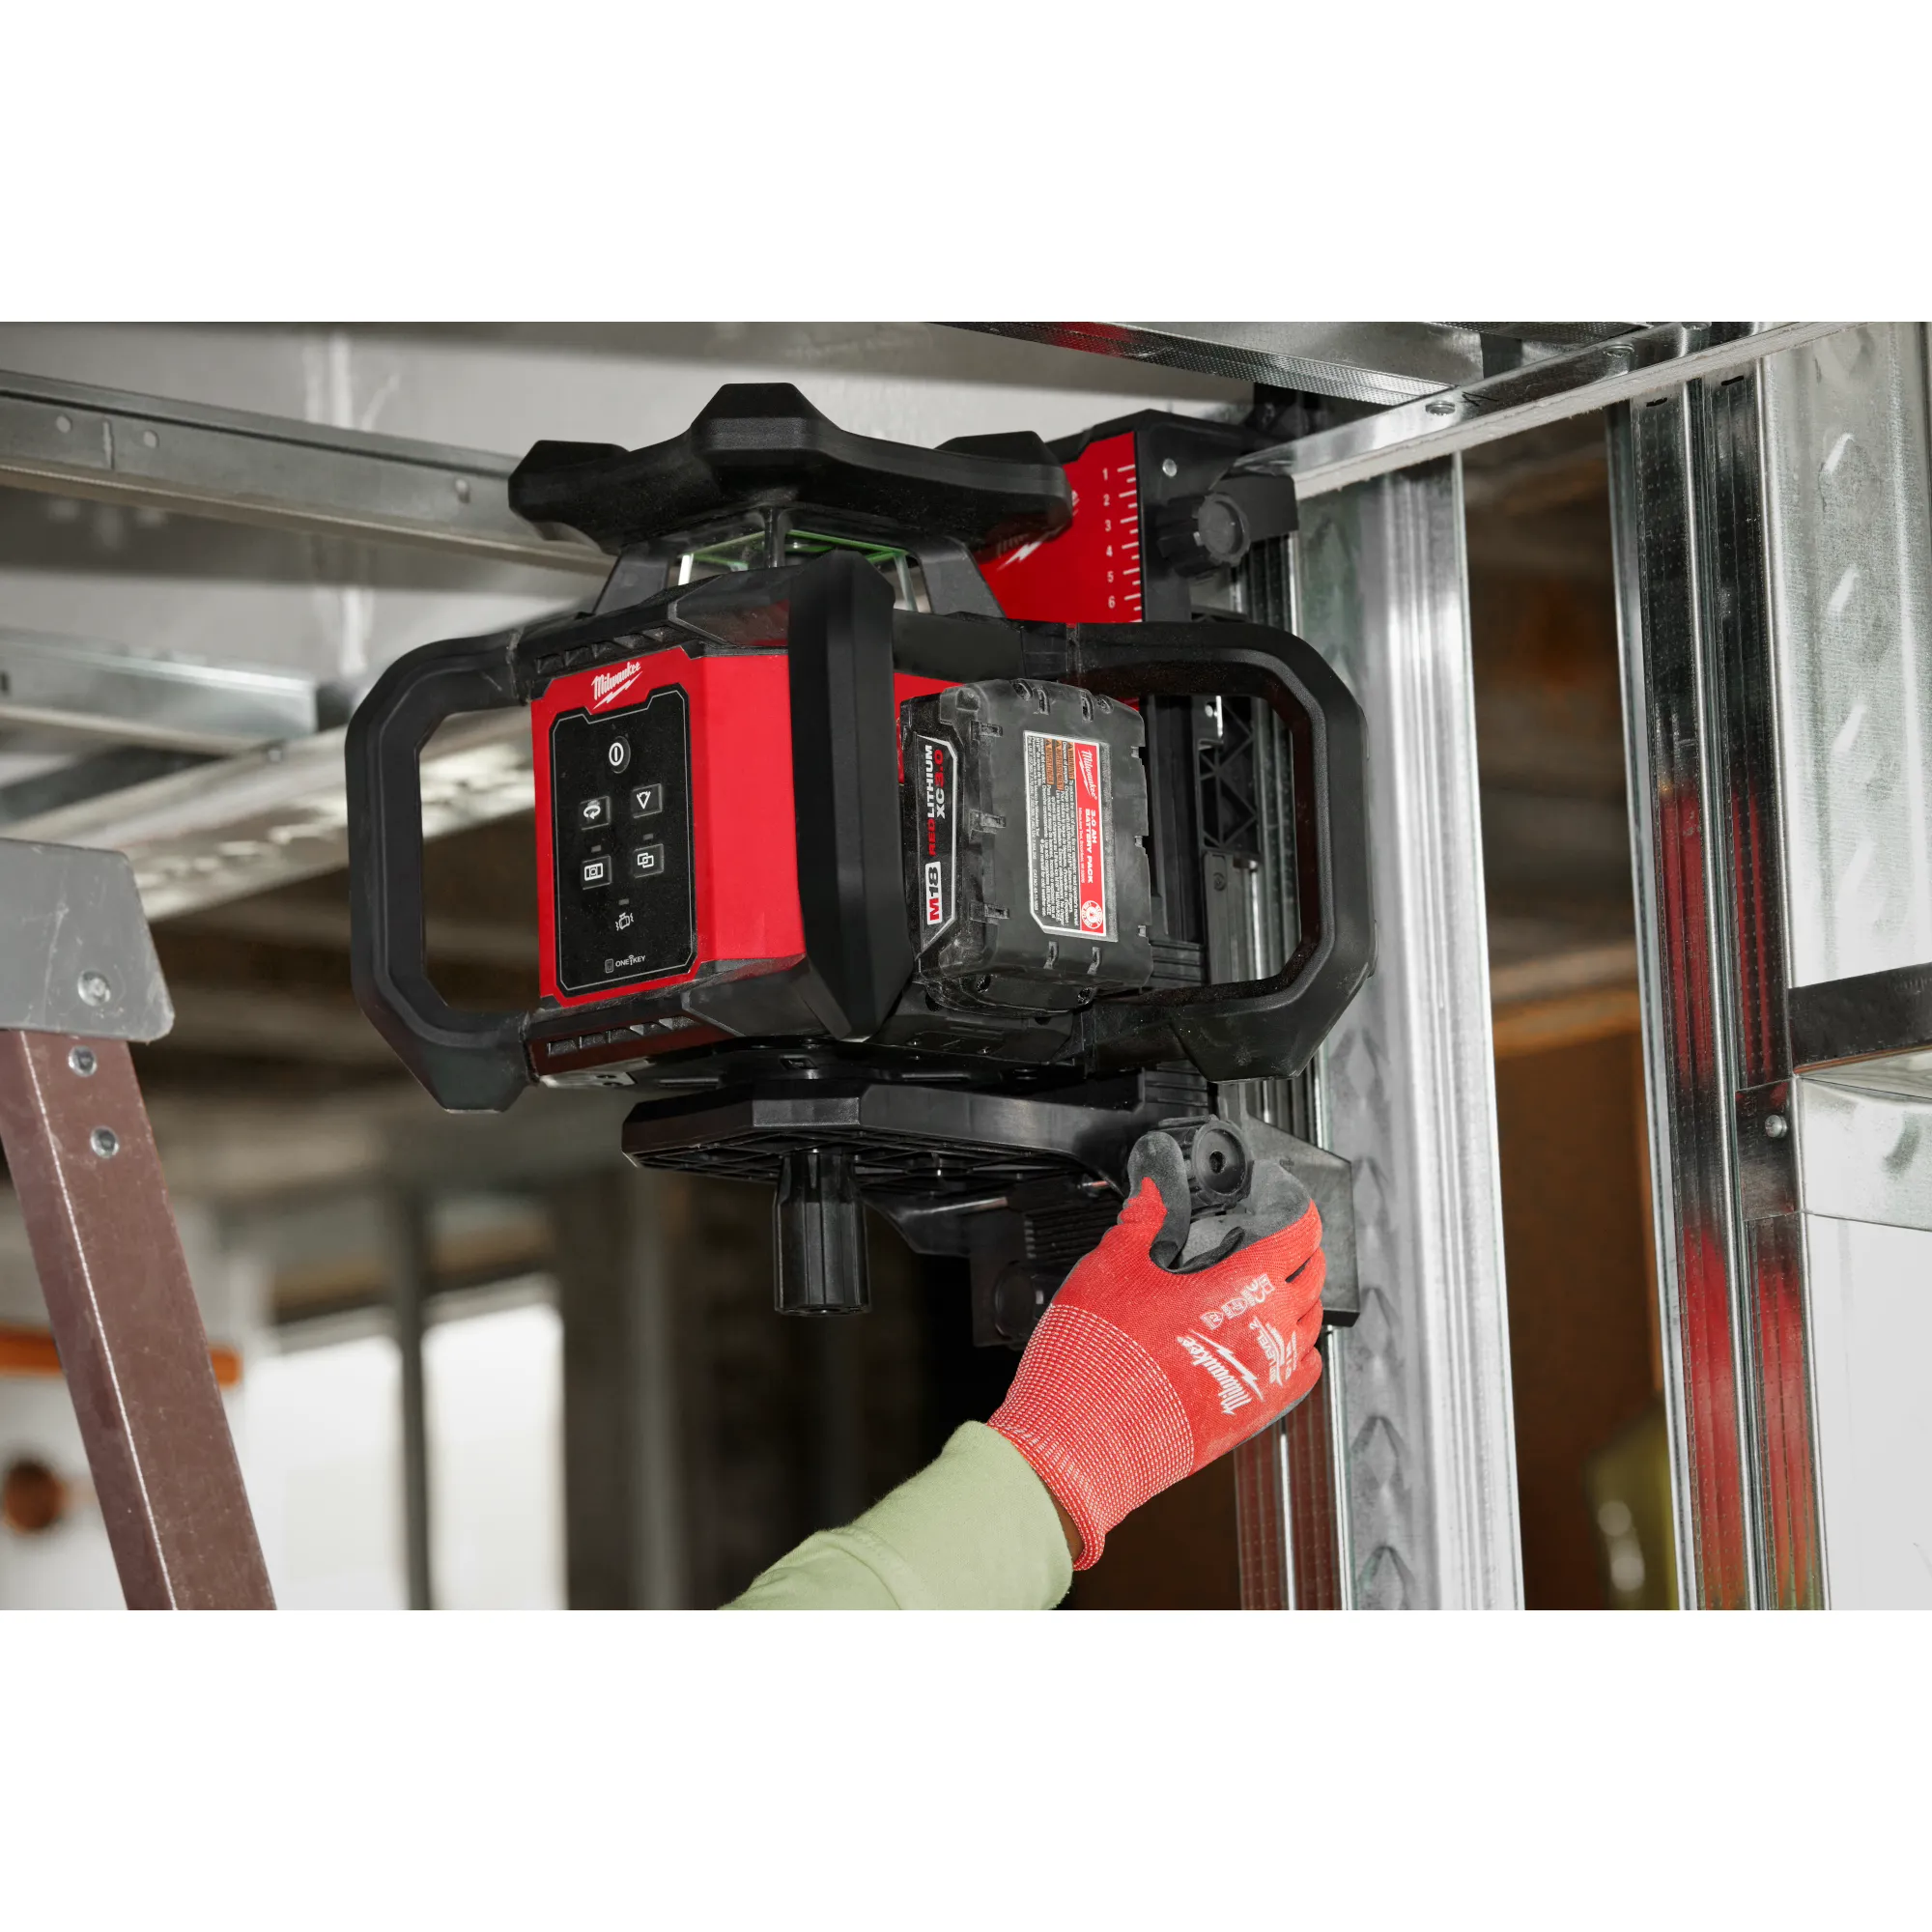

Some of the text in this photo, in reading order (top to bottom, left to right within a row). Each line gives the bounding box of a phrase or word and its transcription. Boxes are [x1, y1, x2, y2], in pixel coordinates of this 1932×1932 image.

[1102, 468, 1109, 481] 1
[1103, 494, 1110, 506] 2
[1105, 519, 1112, 532] 3
[1106, 545, 1113, 557] 4
[1107, 570, 1114, 583] 5
[1108, 595, 1116, 609] 6
[590, 662, 641, 700] Milwaukee
[934, 750, 946, 820] XC3.0
[1082, 749, 1096, 797] Milwaukee
[925, 744, 936, 857] REDLITHIUM
[1092, 829, 1096, 843] AH
[928, 867, 939, 922] M18
[1256, 1329, 1276, 1366] LEVEL
[1180, 1335, 1253, 1415] Milwaukee
